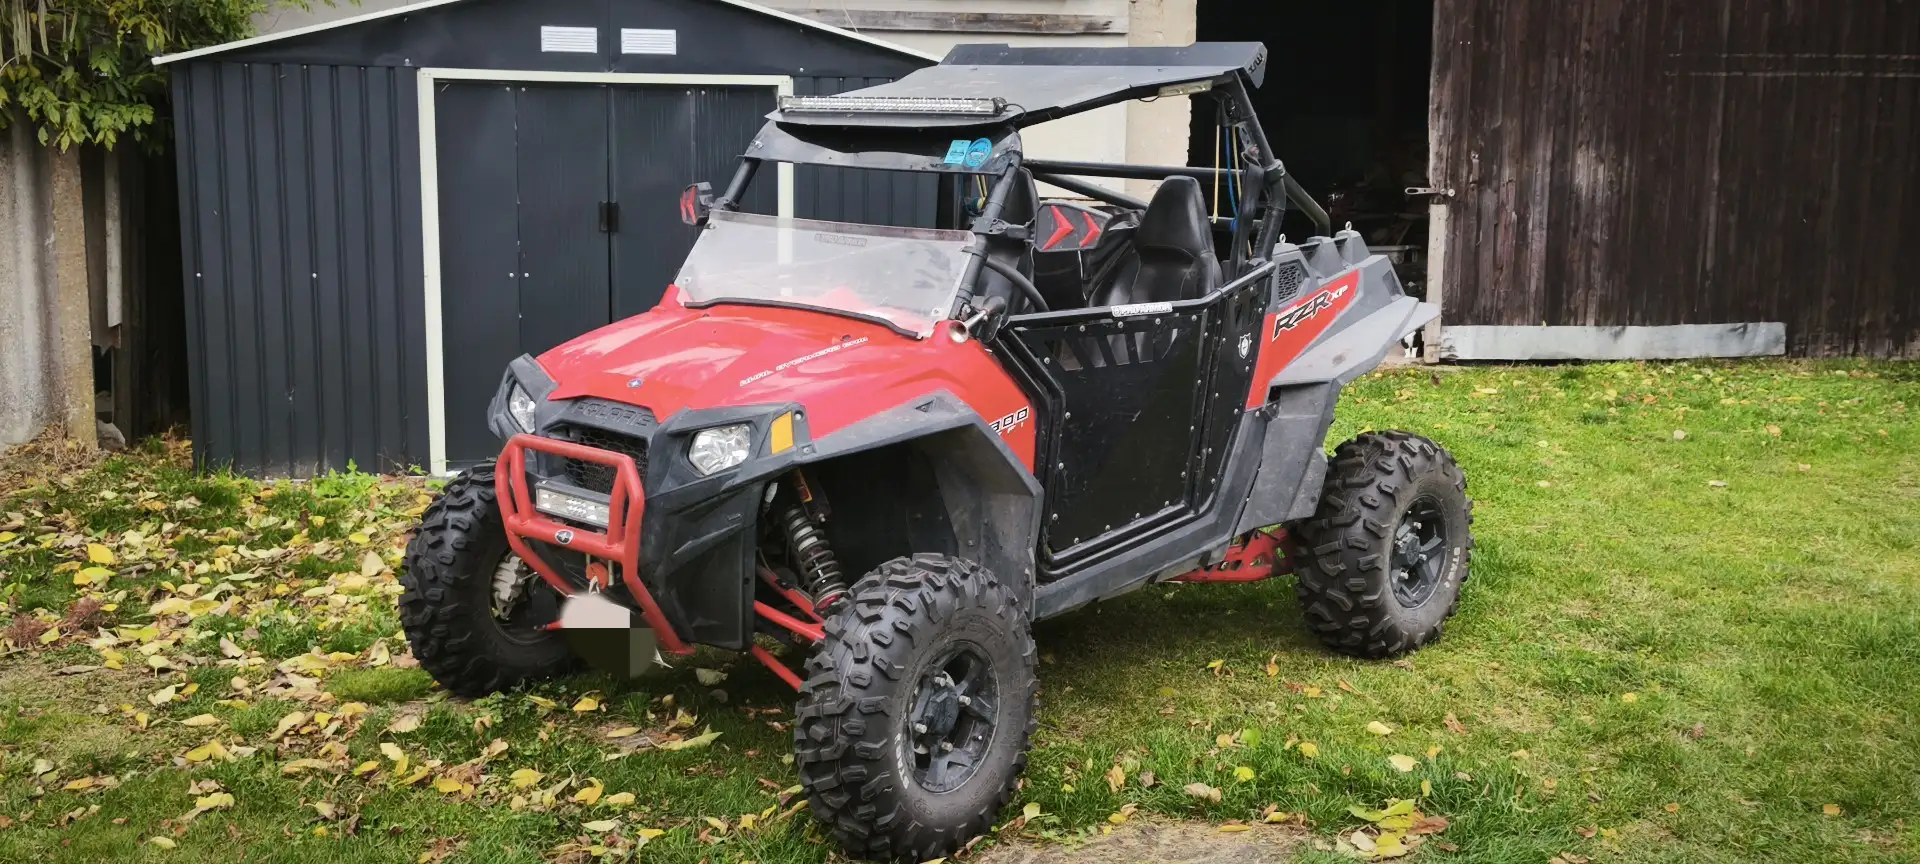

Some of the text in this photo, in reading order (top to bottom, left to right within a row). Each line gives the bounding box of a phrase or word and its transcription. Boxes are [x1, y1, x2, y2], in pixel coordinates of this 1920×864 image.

[1272, 290, 1332, 342] RZR
[1331, 285, 1348, 301] XP
[572, 401, 655, 427] POLARIS
